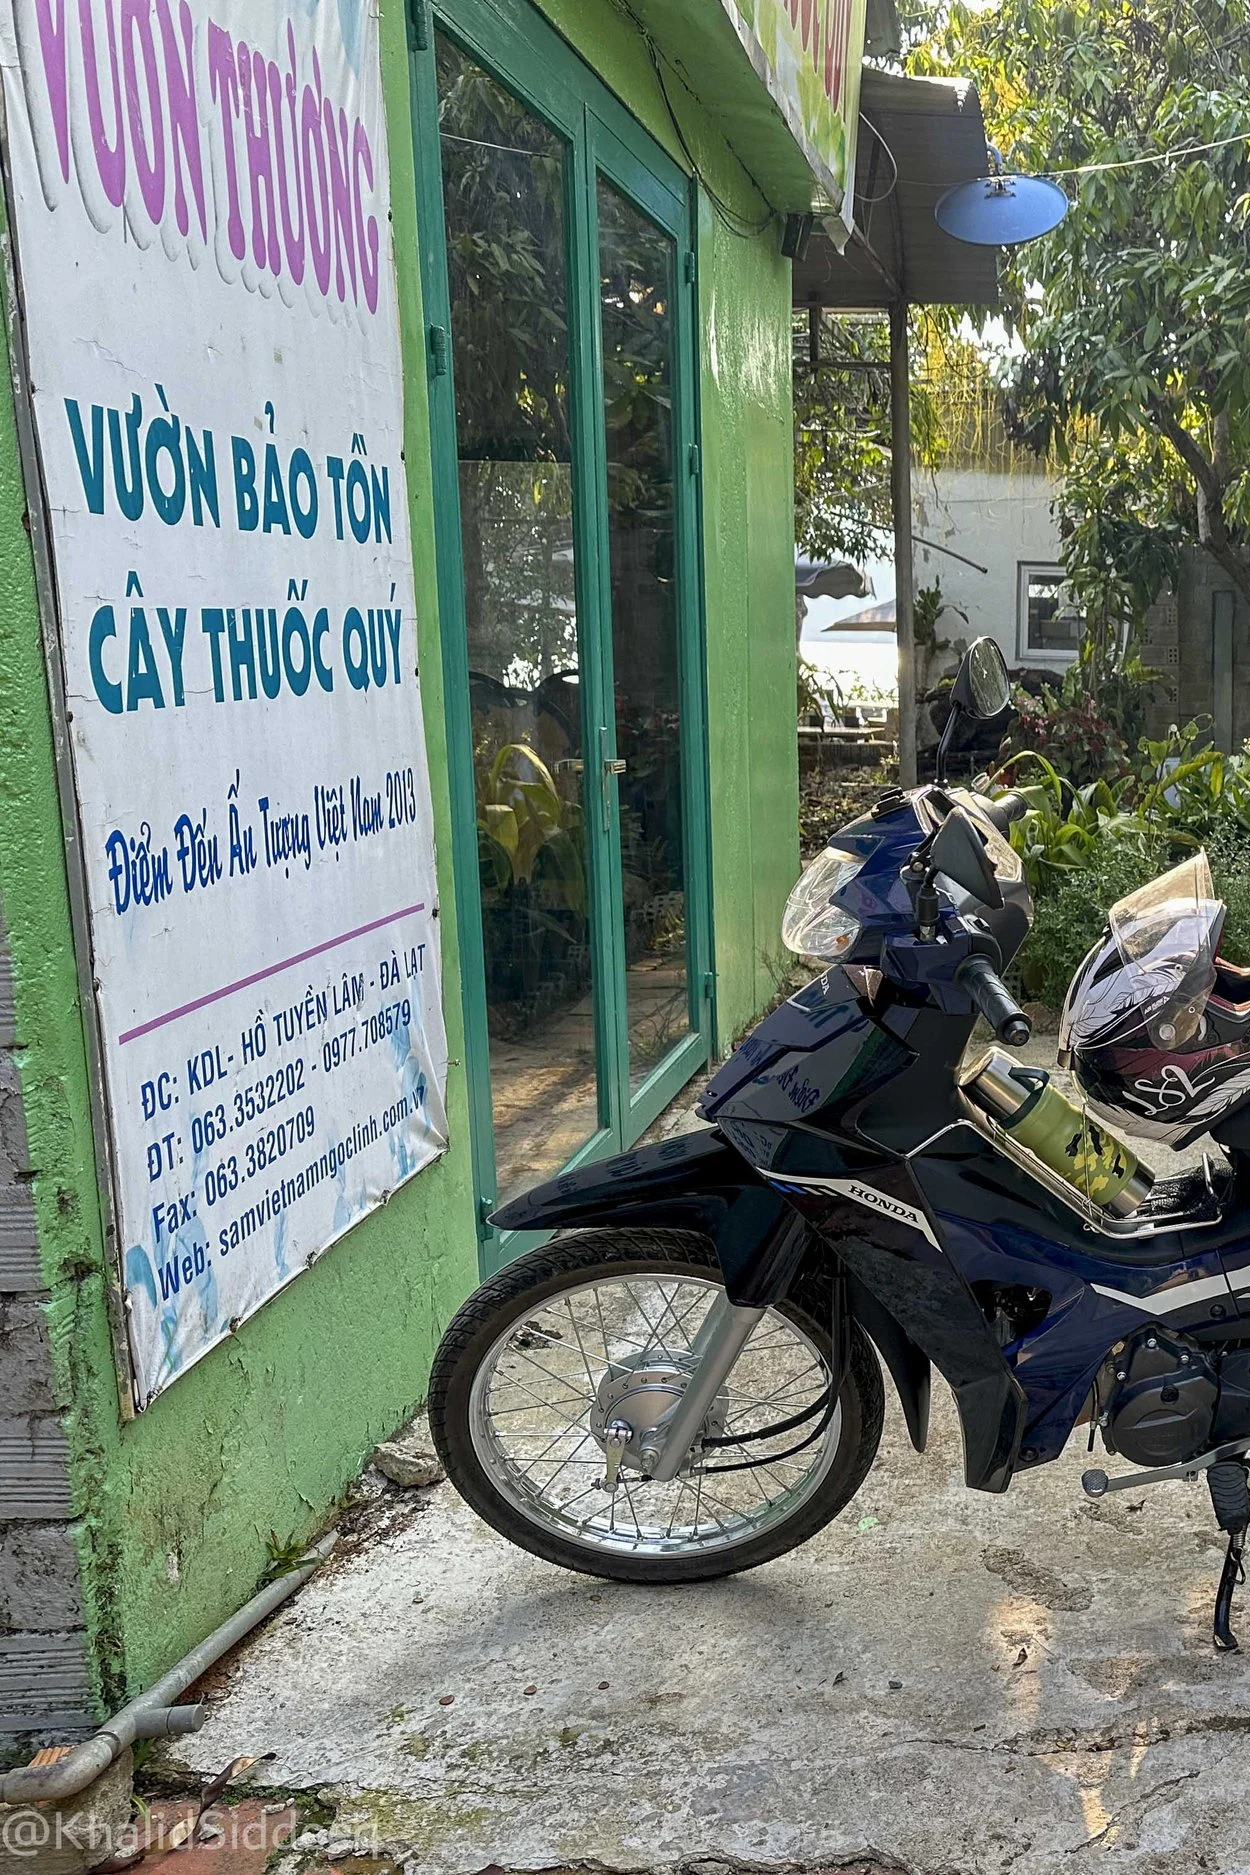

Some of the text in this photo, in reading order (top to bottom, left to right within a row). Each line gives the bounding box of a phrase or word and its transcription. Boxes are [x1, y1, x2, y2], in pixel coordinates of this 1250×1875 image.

[63, 382, 393, 545] VƯỜN BẢO TỒN
[88, 570, 402, 715] CÂY THUỐC QUÝ
[105, 767, 416, 915] Điểm Đến Ấn Tượng Việt Nam 2013
[140, 1071, 180, 1122] ĐC:
[241, 1008, 268, 1066] HỒ
[272, 984, 328, 1047] TUYỀN
[332, 972, 365, 1016] LÂM
[379, 950, 401, 991] ĐÀ
[146, 1131, 184, 1183] ĐT:
[191, 1057, 306, 1155] 063.3532202
[322, 998, 411, 1074] 0977.708579
[152, 1104, 315, 1245] Fax: 063.3820709
[847, 1184, 919, 1224] HONDA
[157, 1240, 213, 1302] Web:
